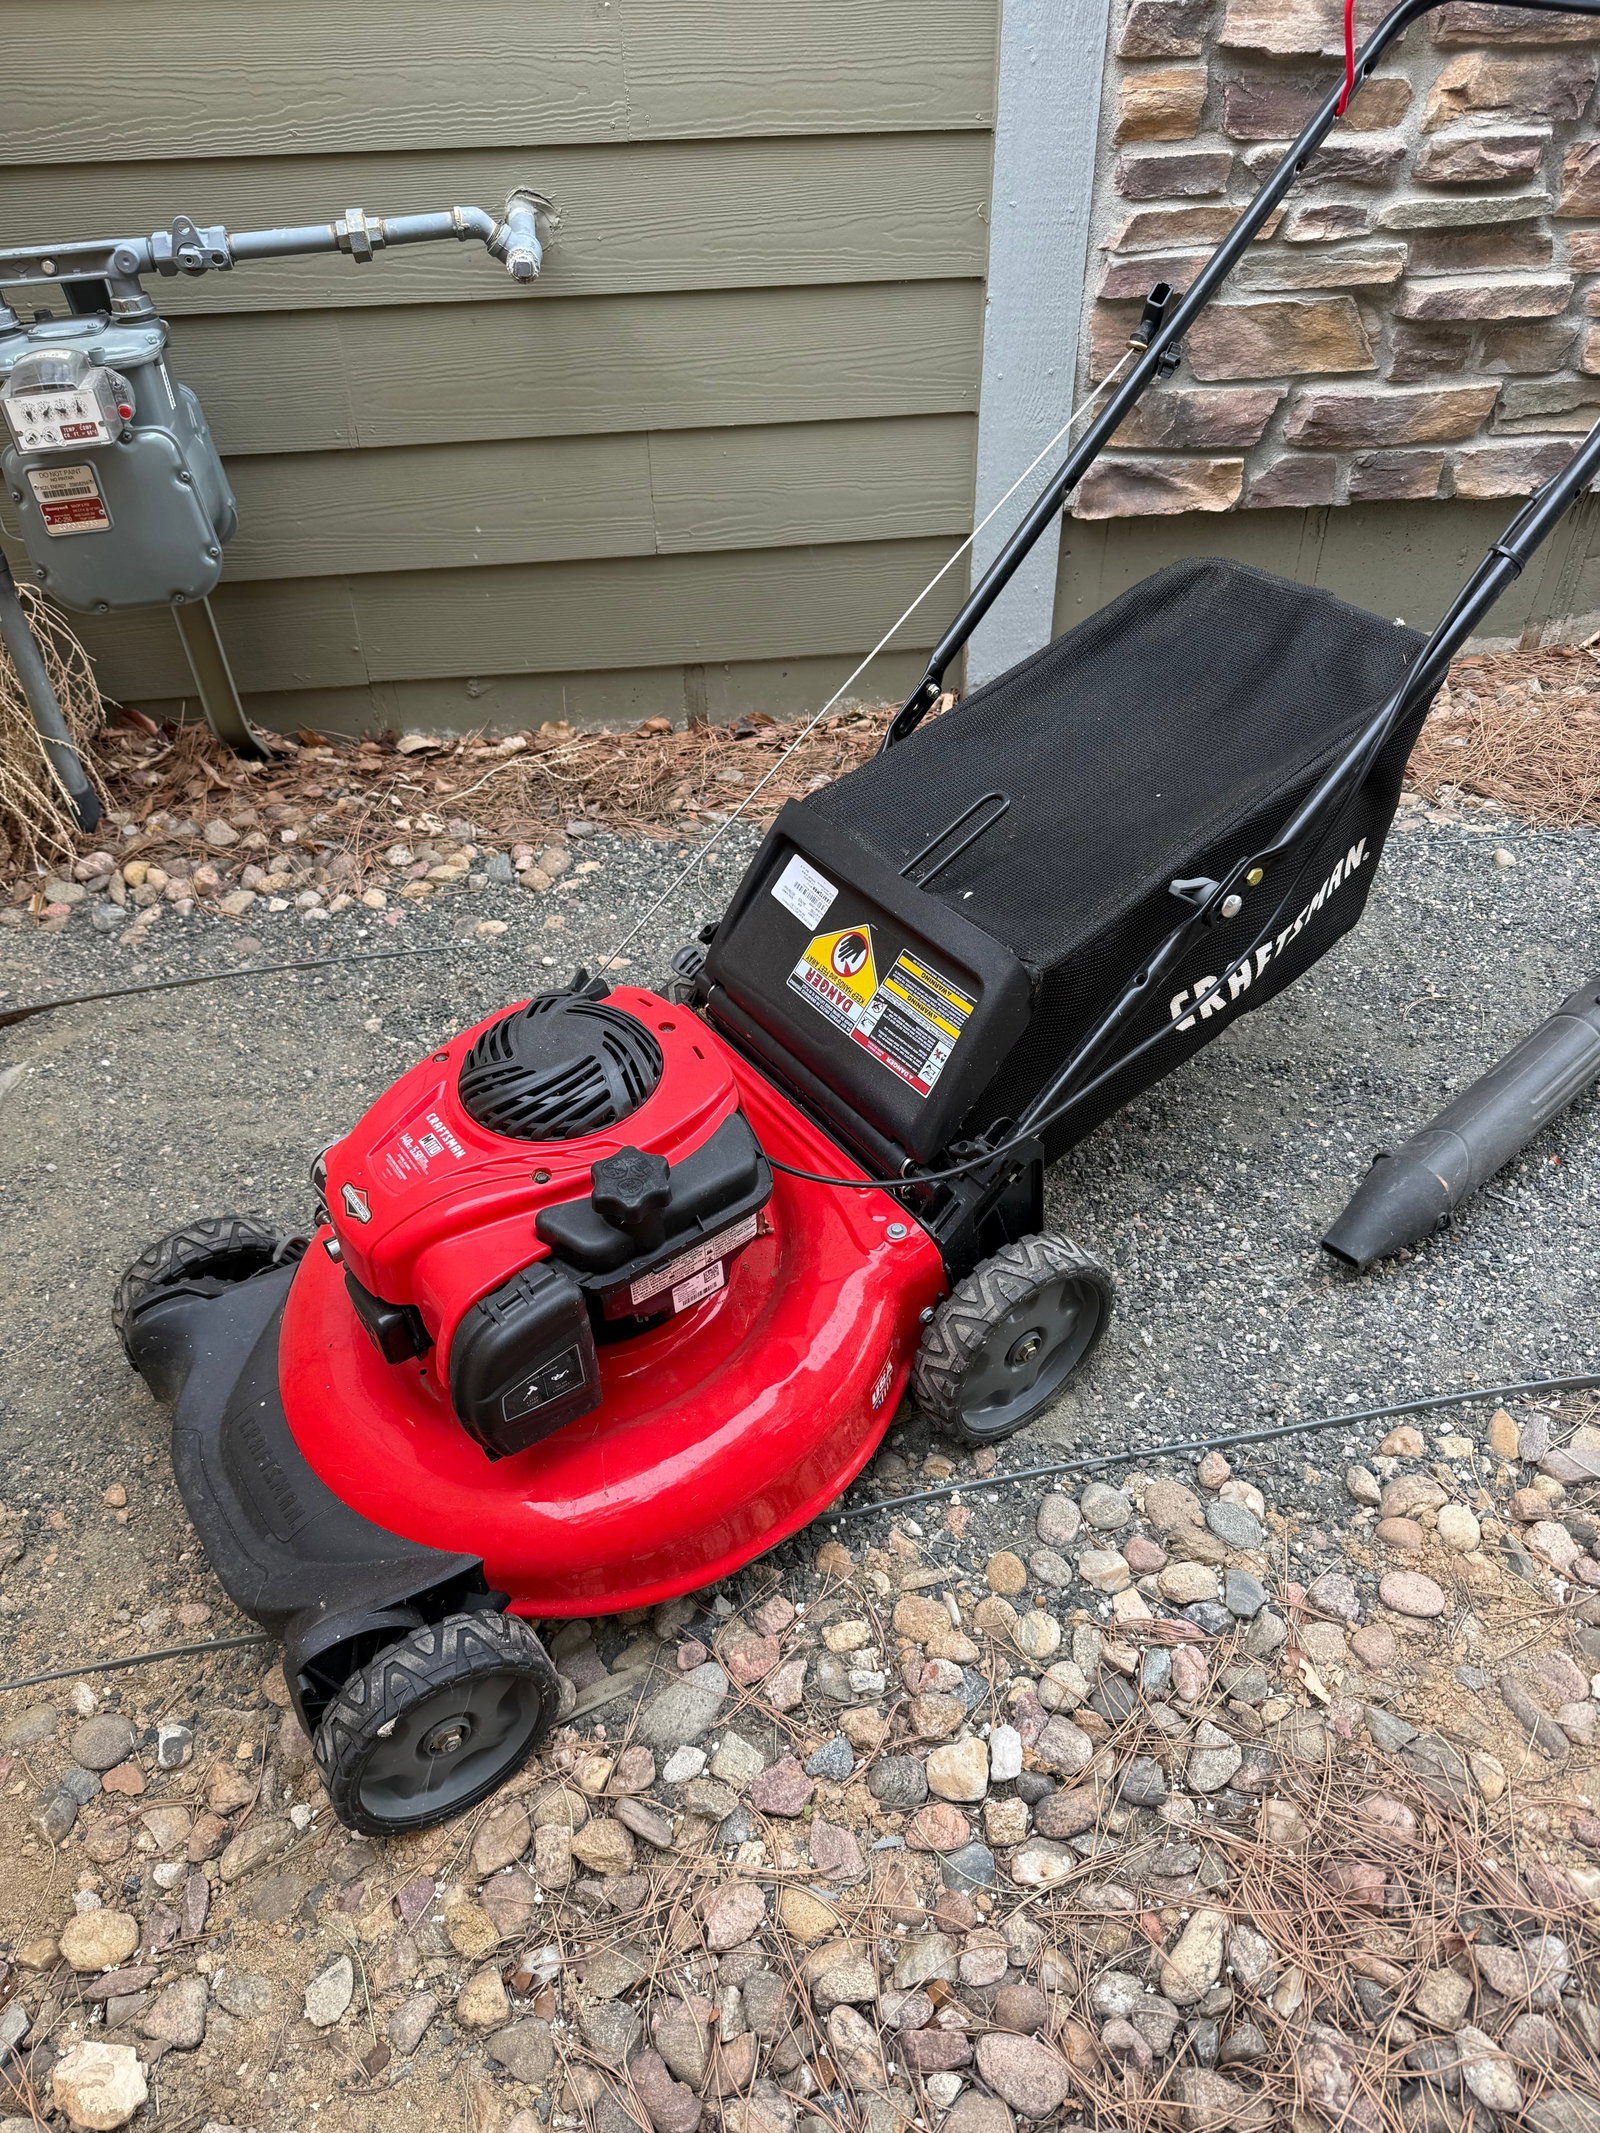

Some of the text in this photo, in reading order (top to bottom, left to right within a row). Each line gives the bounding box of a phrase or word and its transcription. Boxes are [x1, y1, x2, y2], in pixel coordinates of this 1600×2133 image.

[54, 516, 72, 524] AC-250
[806, 954, 820, 967] AWAY
[819, 964, 829, 977] FEET
[829, 971, 839, 981] and
[805, 967, 854, 1013] DANGER
[837, 979, 852, 993] HANDS
[921, 972, 948, 997] WARNING
[852, 991, 866, 1004] KEEP
[907, 995, 934, 1019] WARNING
[886, 1056, 909, 1078] DANGER
[409, 1146, 426, 1161] 5.50
